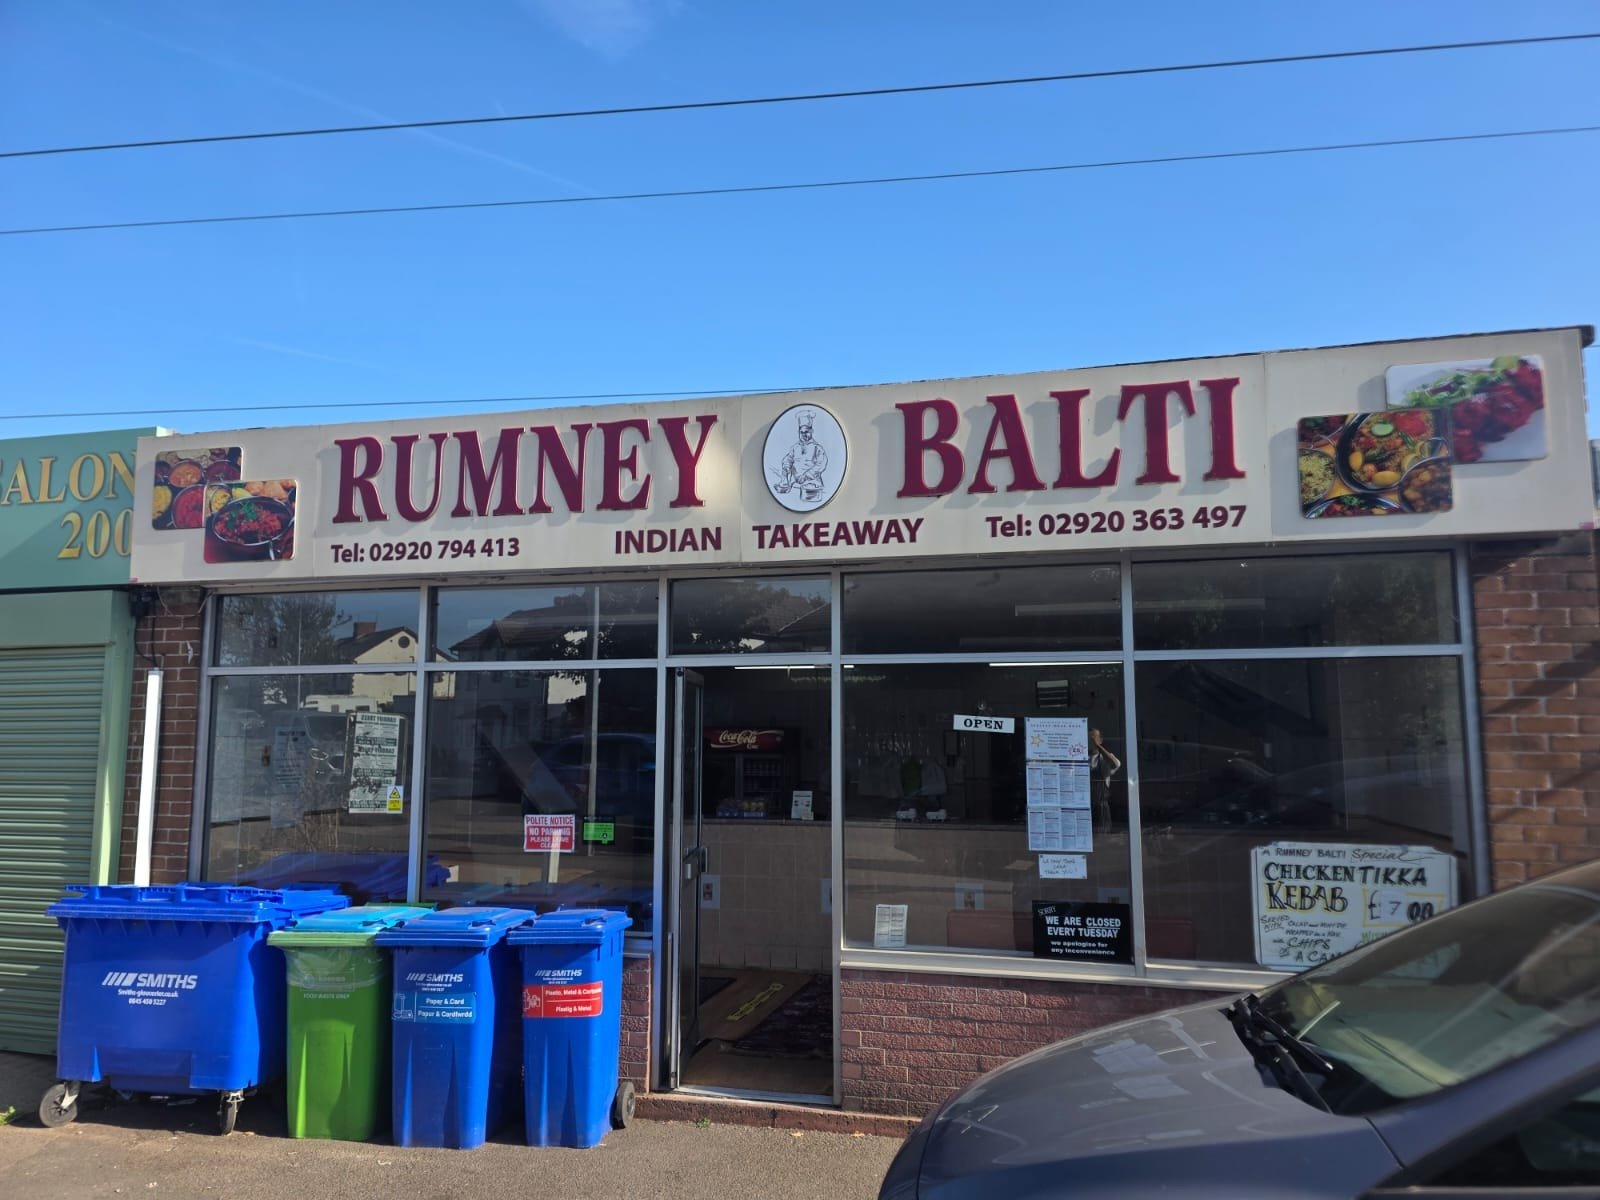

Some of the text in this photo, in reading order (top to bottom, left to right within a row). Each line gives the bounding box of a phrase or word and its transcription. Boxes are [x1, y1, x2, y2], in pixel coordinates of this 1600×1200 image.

[332, 377, 1247, 524] RUMNEY BALTI
[0, 451, 136, 505] ALON
[985, 504, 1247, 538] Tel: 02920 363 497
[614, 517, 925, 554] INDIAN TAKEAWAY
[331, 537, 520, 563] Tel: 02920 794 413
[963, 718, 1005, 730] OPEN
[719, 730, 757, 745] Coca-Cola
[526, 816, 574, 825] POLITE NOTICE
[529, 827, 539, 836] NO
[1275, 848, 1311, 857] RUMNEY
[1317, 848, 1346, 858] BALTI
[1264, 861, 1428, 887] CHICKEN TIKKA
[1264, 881, 1349, 912] KEBAB
[1038, 905, 1057, 916] SORRY
[1045, 915, 1122, 928] WE ARE CLOSED
[1047, 927, 1119, 938] EVERY TUESDAY
[1287, 936, 1331, 950] CHIPS
[425, 973, 464, 983] SMITHS
[551, 969, 583, 977] SMITHS
[136, 972, 198, 989] SMITHS
[425, 998, 443, 1006] Paper
